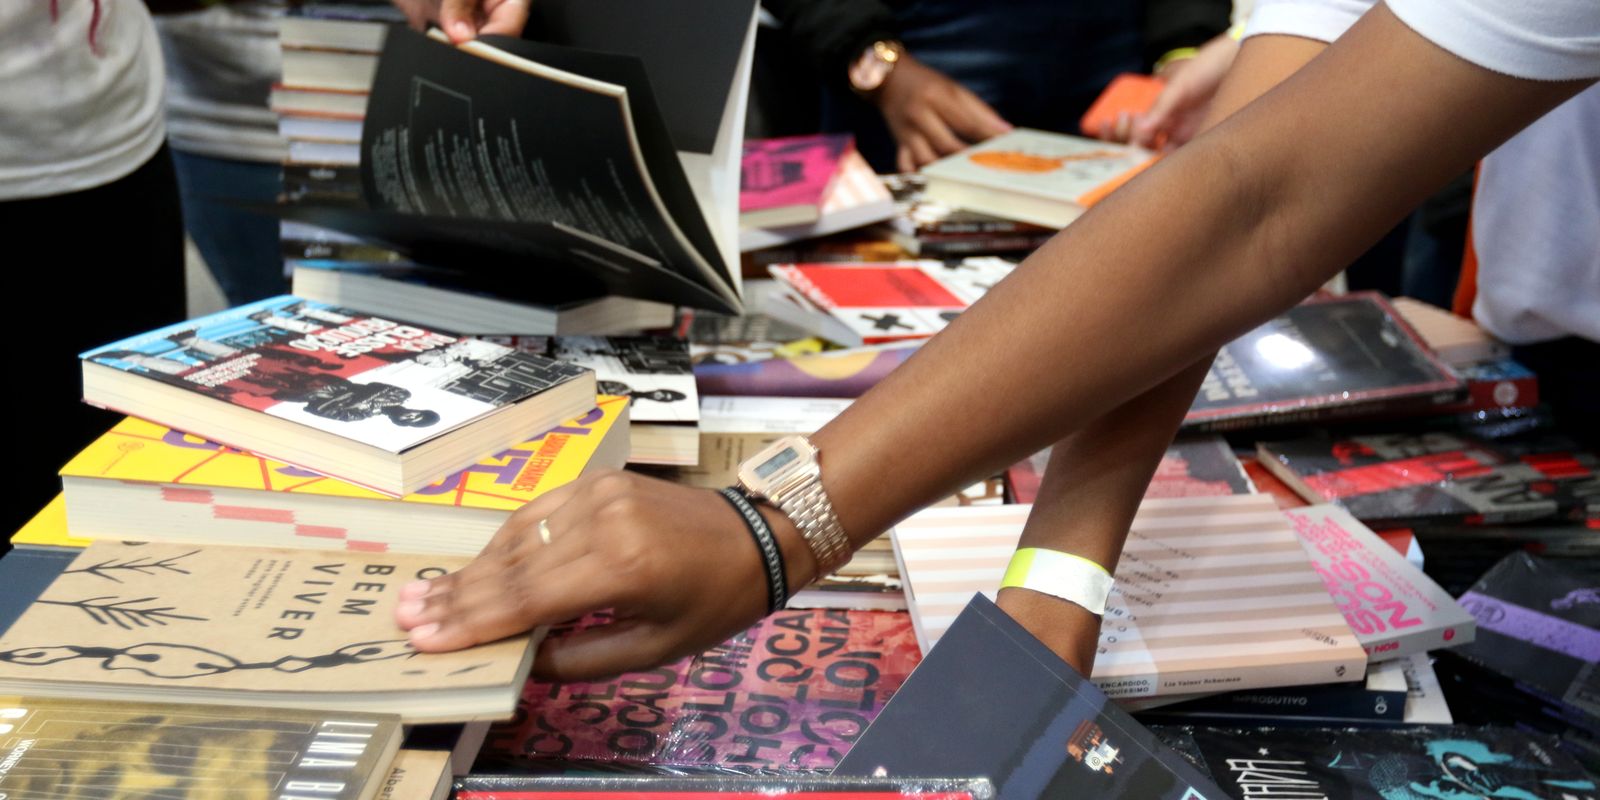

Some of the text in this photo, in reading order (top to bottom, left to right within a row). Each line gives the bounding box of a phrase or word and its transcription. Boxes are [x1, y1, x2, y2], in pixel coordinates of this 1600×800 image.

[266, 563, 346, 640] VIVER
[338, 564, 396, 615] BEM
[298, 720, 379, 768] LIMA
